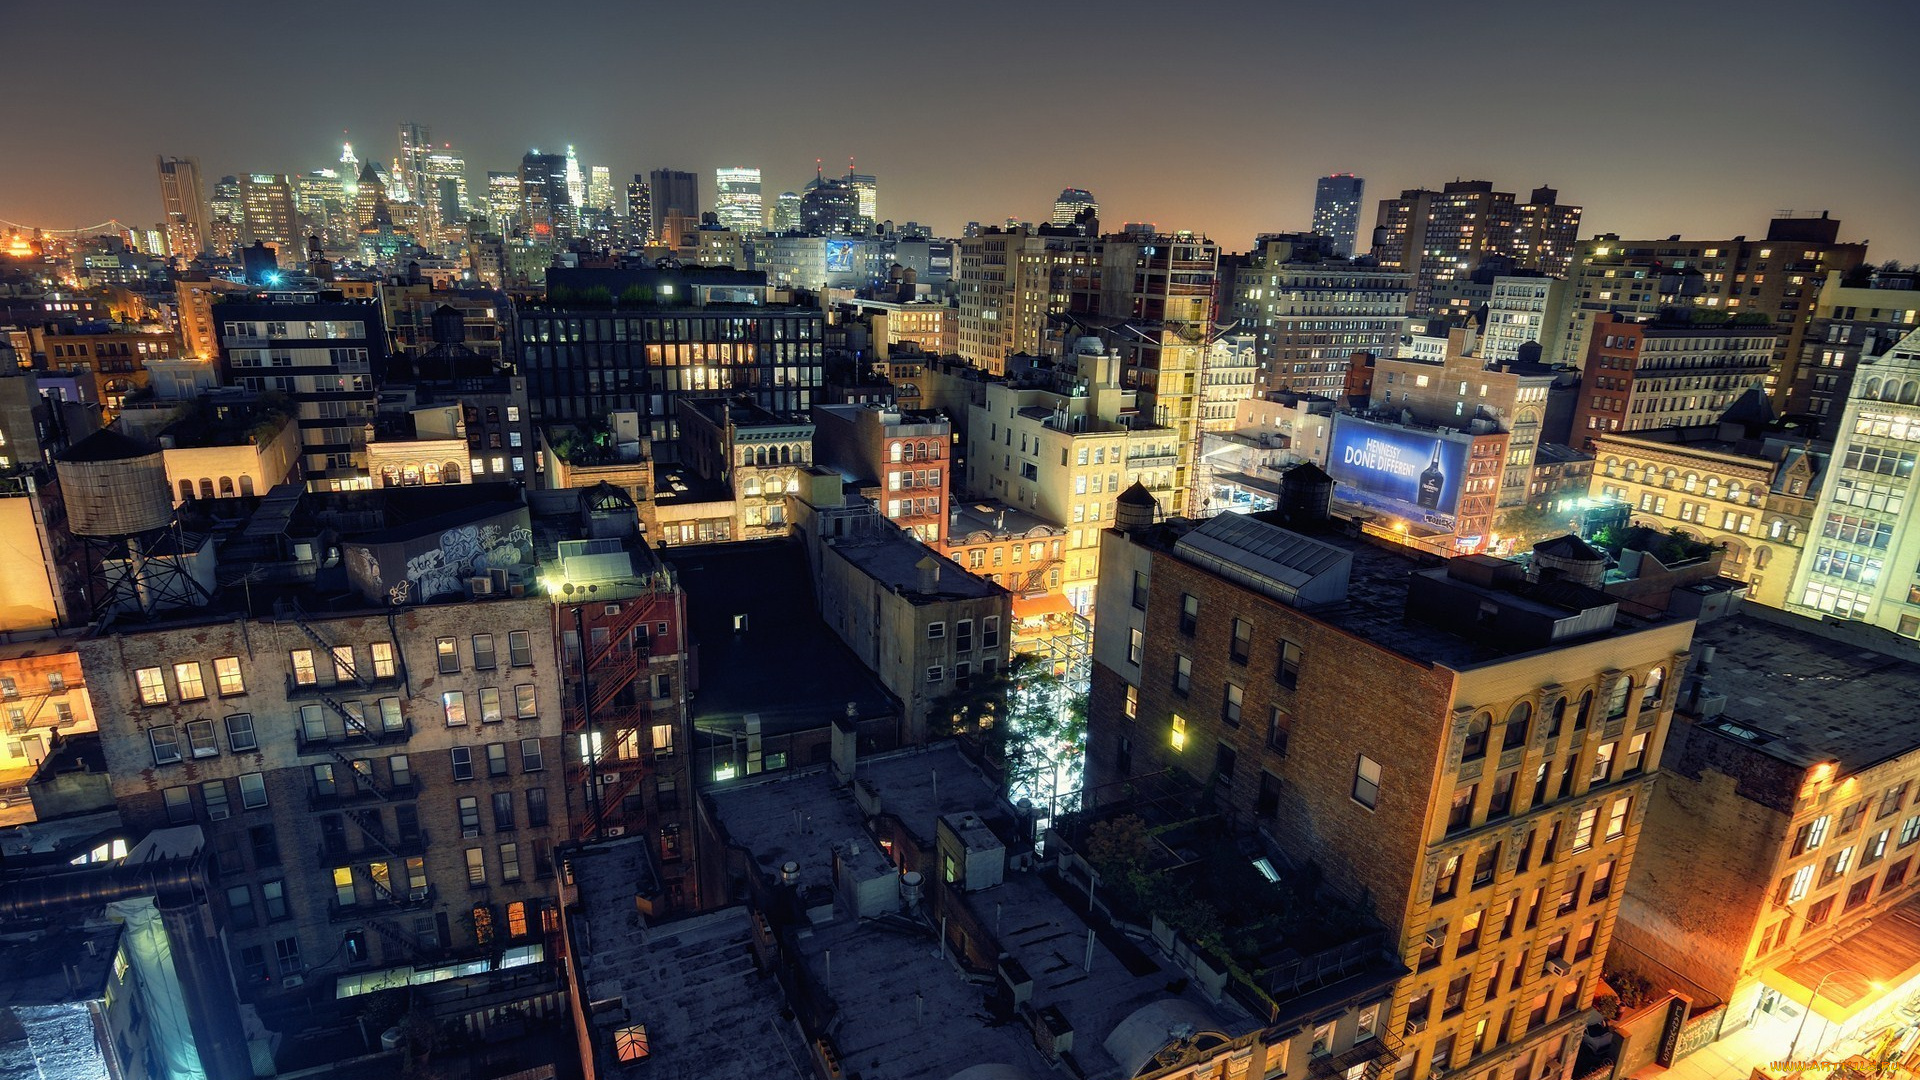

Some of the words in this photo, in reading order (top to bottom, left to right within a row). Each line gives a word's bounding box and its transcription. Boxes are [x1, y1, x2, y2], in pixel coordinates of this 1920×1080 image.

[1344, 445, 1377, 469] DONE
[1377, 455, 1416, 477] DIFFERENT
[1366, 437, 1402, 460] HENNESSY
